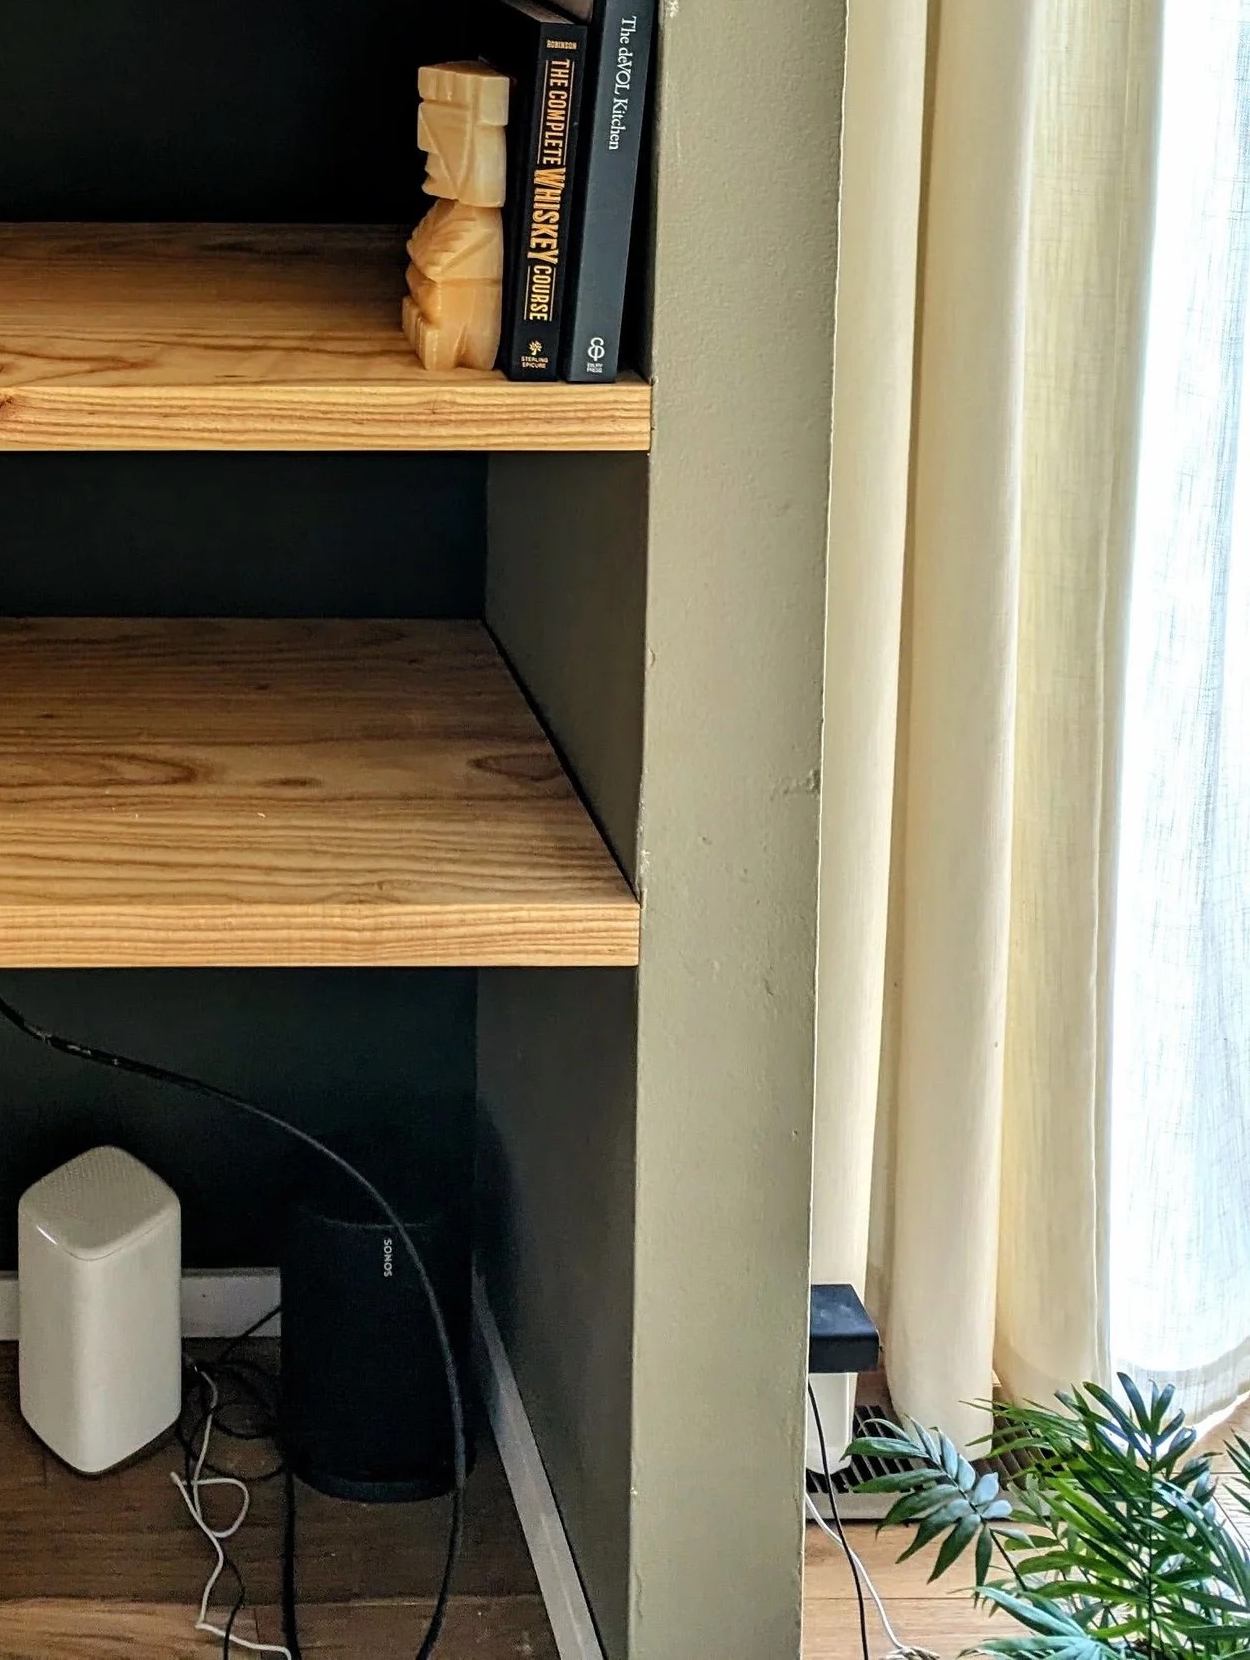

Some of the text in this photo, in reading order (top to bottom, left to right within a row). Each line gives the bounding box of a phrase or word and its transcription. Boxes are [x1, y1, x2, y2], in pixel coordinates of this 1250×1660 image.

[608, 16, 637, 150] The deVOL Kitchen
[527, 58, 571, 321] THE COMPLETE WHISKEY COURSE
[522, 361, 546, 369] EPICURE
[383, 1238, 393, 1278] SONOS
